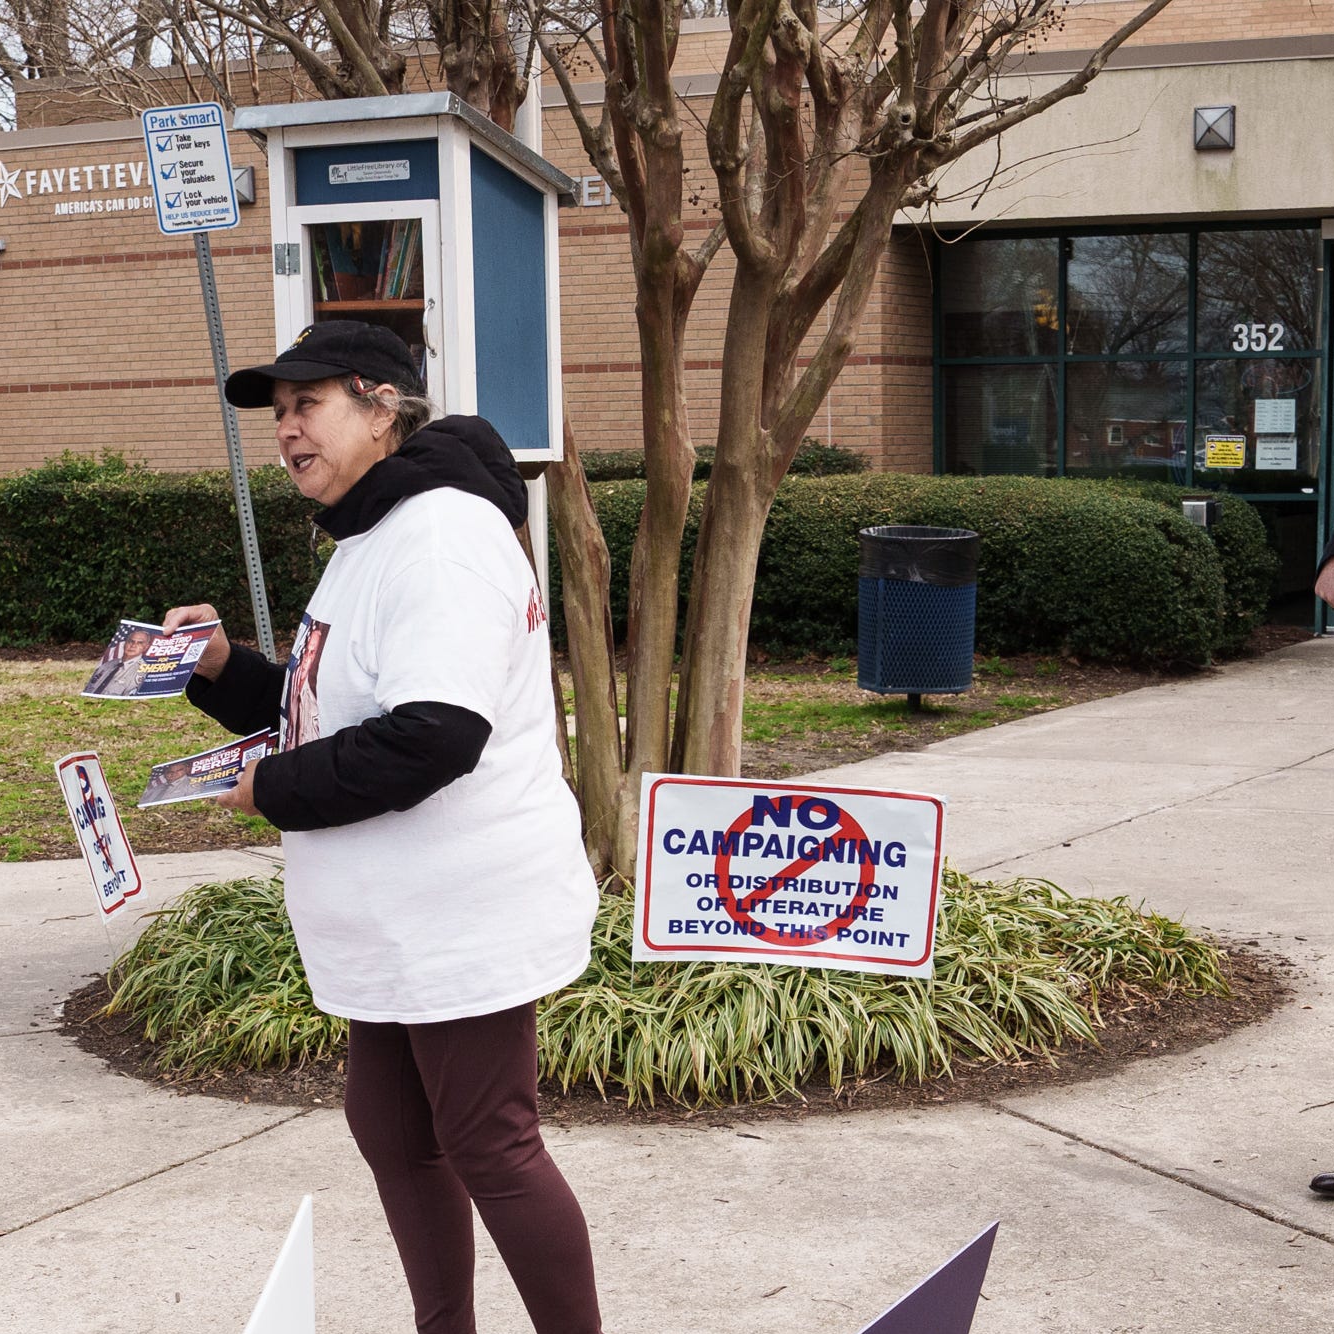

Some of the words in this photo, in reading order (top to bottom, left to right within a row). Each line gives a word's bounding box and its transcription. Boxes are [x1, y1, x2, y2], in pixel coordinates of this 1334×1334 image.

[150, 115, 177, 129] Park
[181, 110, 216, 126] Smart
[175, 134, 191, 142] Take
[176, 142, 192, 151] your
[194, 140, 210, 149] keys
[179, 160, 203, 169] Secure
[181, 169, 196, 178] your
[182, 175, 215, 184] valuables
[184, 190, 202, 199] Lock
[186, 199, 202, 208] your
[203, 195, 228, 205] vehicle
[55, 200, 103, 216] AMERICA'S
[106, 198, 125, 212] CAN
[128, 197, 140, 209] DO
[165, 211, 179, 220] HELP
[181, 211, 189, 219] US
[190, 209, 211, 218] REDUCE
[213, 207, 230, 216] CRIME
[1233, 323, 1283, 352] 352
[146, 643, 188, 656] PEREZ
[137, 661, 180, 673] SHERIFF
[190, 753, 240, 774] PEREZ
[190, 766, 239, 784] SHERIFF
[751, 795, 840, 830] NO
[663, 828, 907, 868] CAMPAIGNING
[685, 873, 720, 889] OR
[728, 874, 899, 900] DISTRIBUTION
[696, 897, 730, 911] OF
[736, 898, 885, 922] LITERATURE
[668, 920, 766, 937] BEYOND
[775, 922, 828, 940] THIS
[837, 927, 910, 948] POINT
